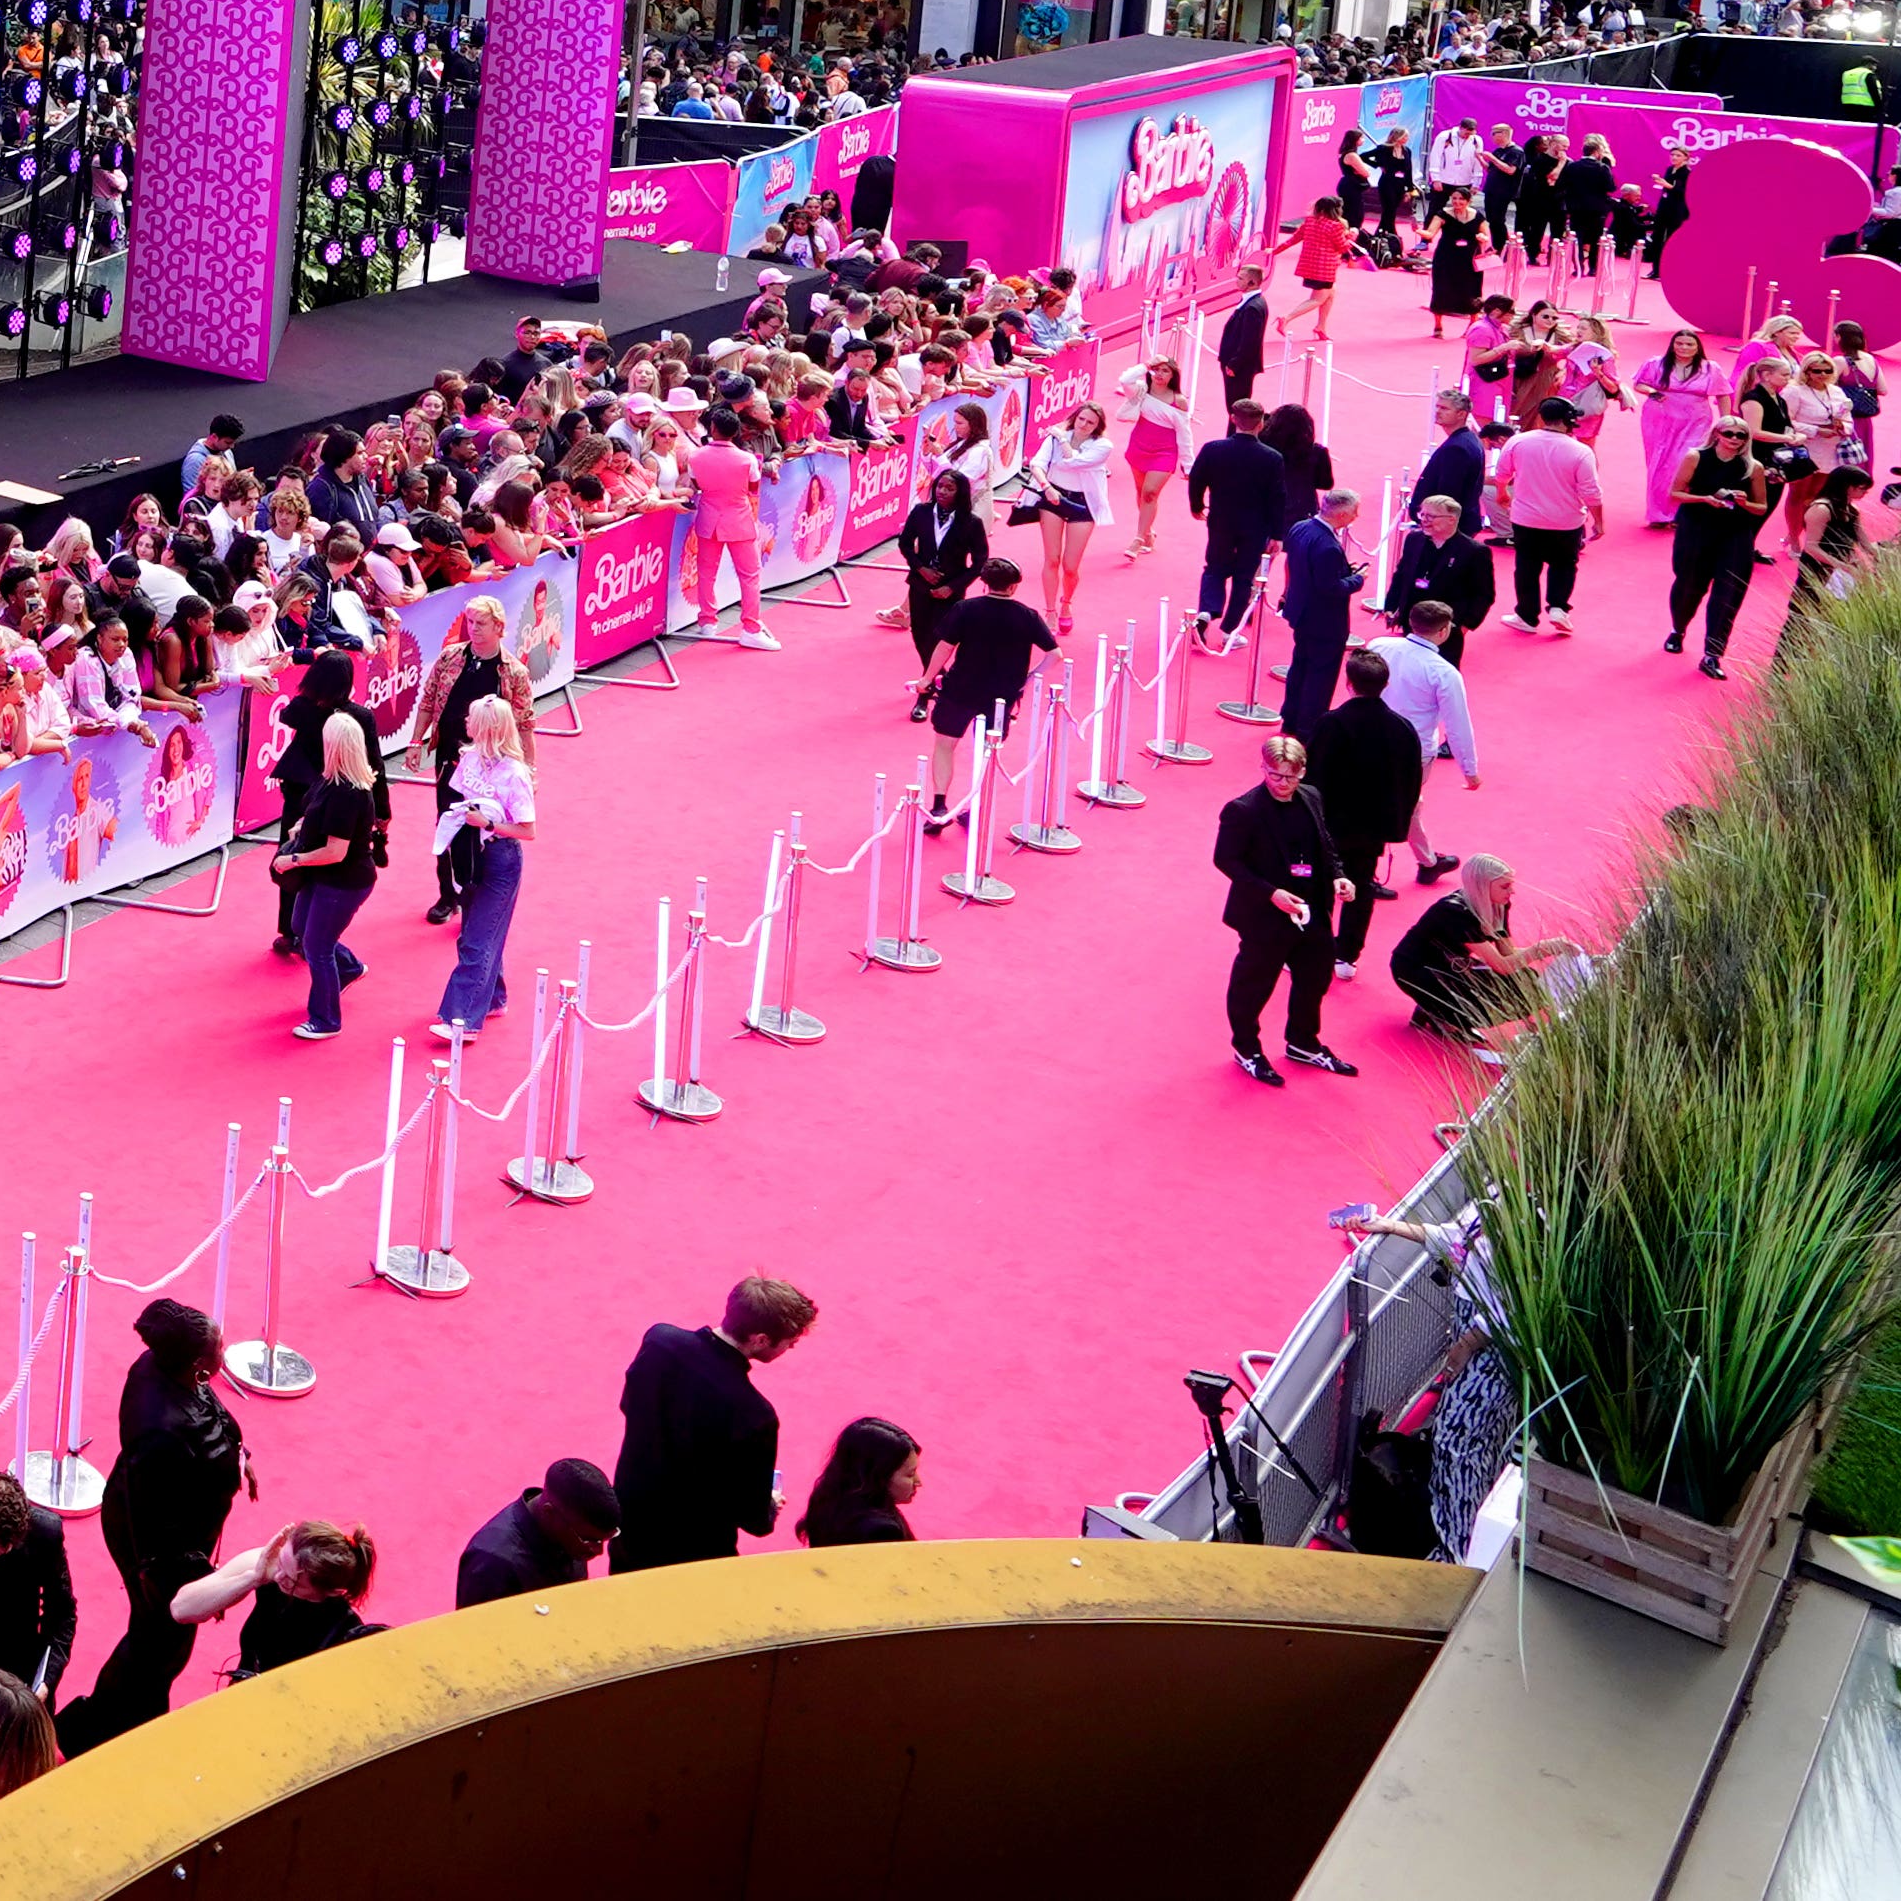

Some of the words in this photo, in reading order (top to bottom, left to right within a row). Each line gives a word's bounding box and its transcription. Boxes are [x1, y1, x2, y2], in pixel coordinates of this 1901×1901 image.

[1301, 98, 1337, 132] Barbie
[838, 124, 871, 166] Barbie
[1124, 112, 1214, 210] Barbie
[608, 180, 667, 218] arbie
[1034, 368, 1091, 424] Barbie
[849, 450, 909, 513] Barbie
[792, 503, 835, 543] Barbie
[584, 541, 665, 617] Barbie
[517, 614, 563, 656] Barbie
[363, 663, 419, 711] Barbie
[144, 760, 214, 820] Barbie
[49, 795, 115, 857] Barbie
